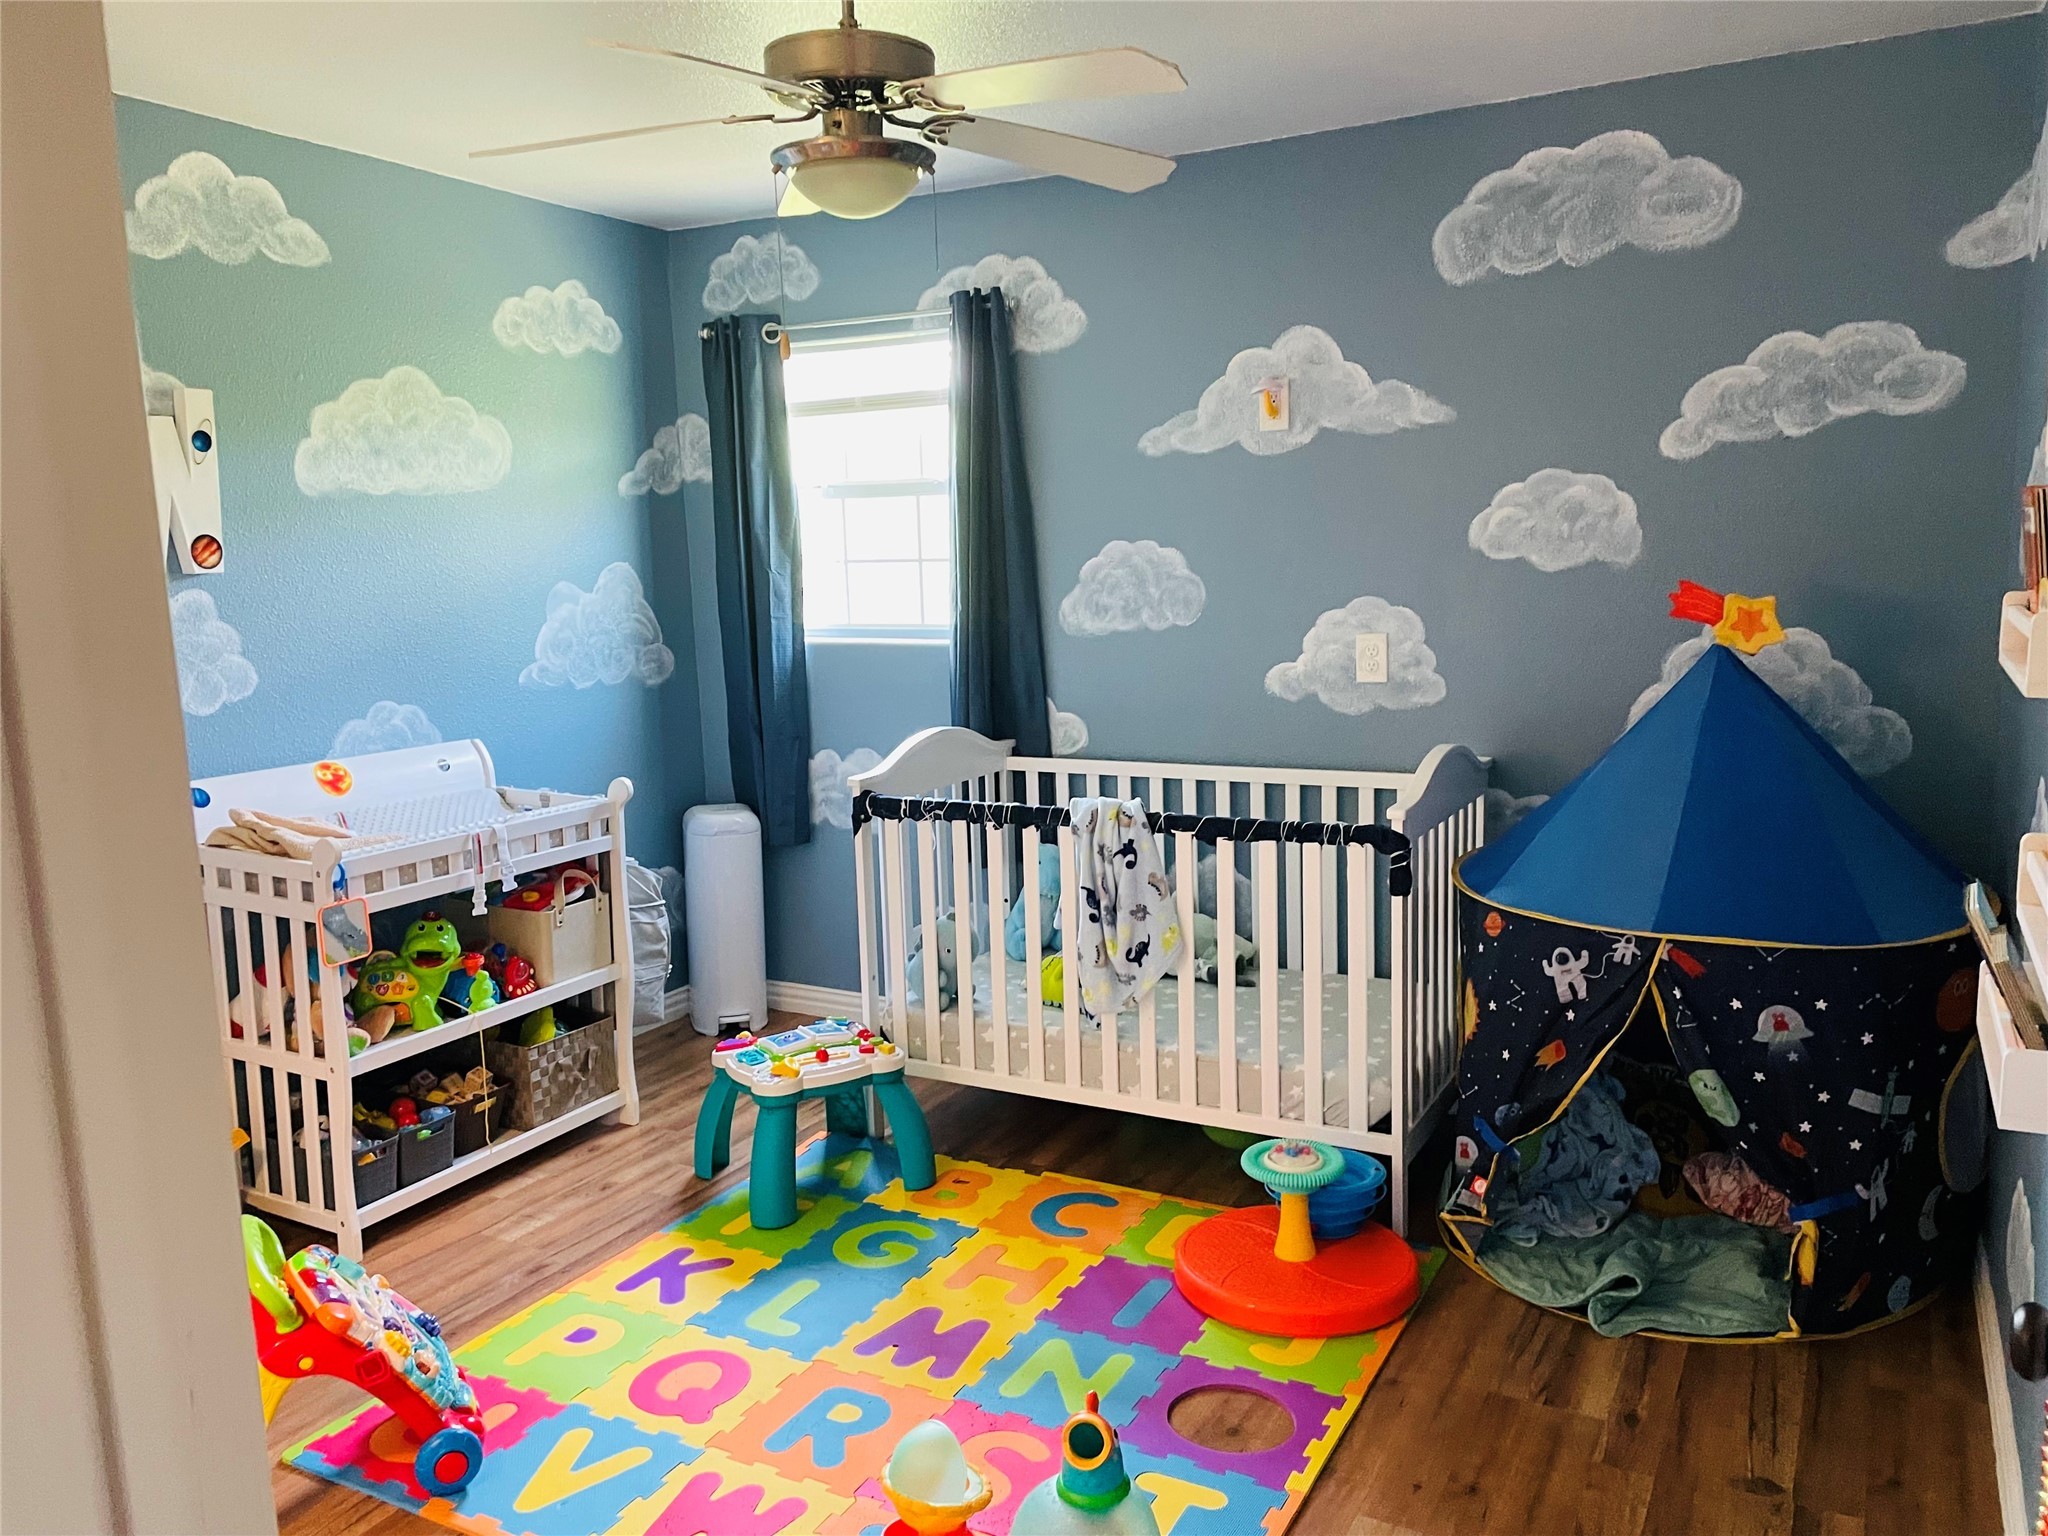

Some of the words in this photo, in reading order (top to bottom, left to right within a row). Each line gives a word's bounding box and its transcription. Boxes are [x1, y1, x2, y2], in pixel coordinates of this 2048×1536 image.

[910, 1169, 993, 1209] B
[1030, 1191, 1120, 1237] C
[832, 1220, 937, 1268] G
[943, 1243, 1068, 1305] H
[1111, 1278, 1173, 1329] I
[615, 1247, 735, 1305] K
[744, 1279, 821, 1337] L
[853, 1306, 991, 1379] M
[999, 1338, 1135, 1414] N
[503, 1313, 626, 1367] P
[628, 1350, 752, 1424] Q
[764, 1387, 893, 1469] R
[513, 1427, 654, 1513] V
